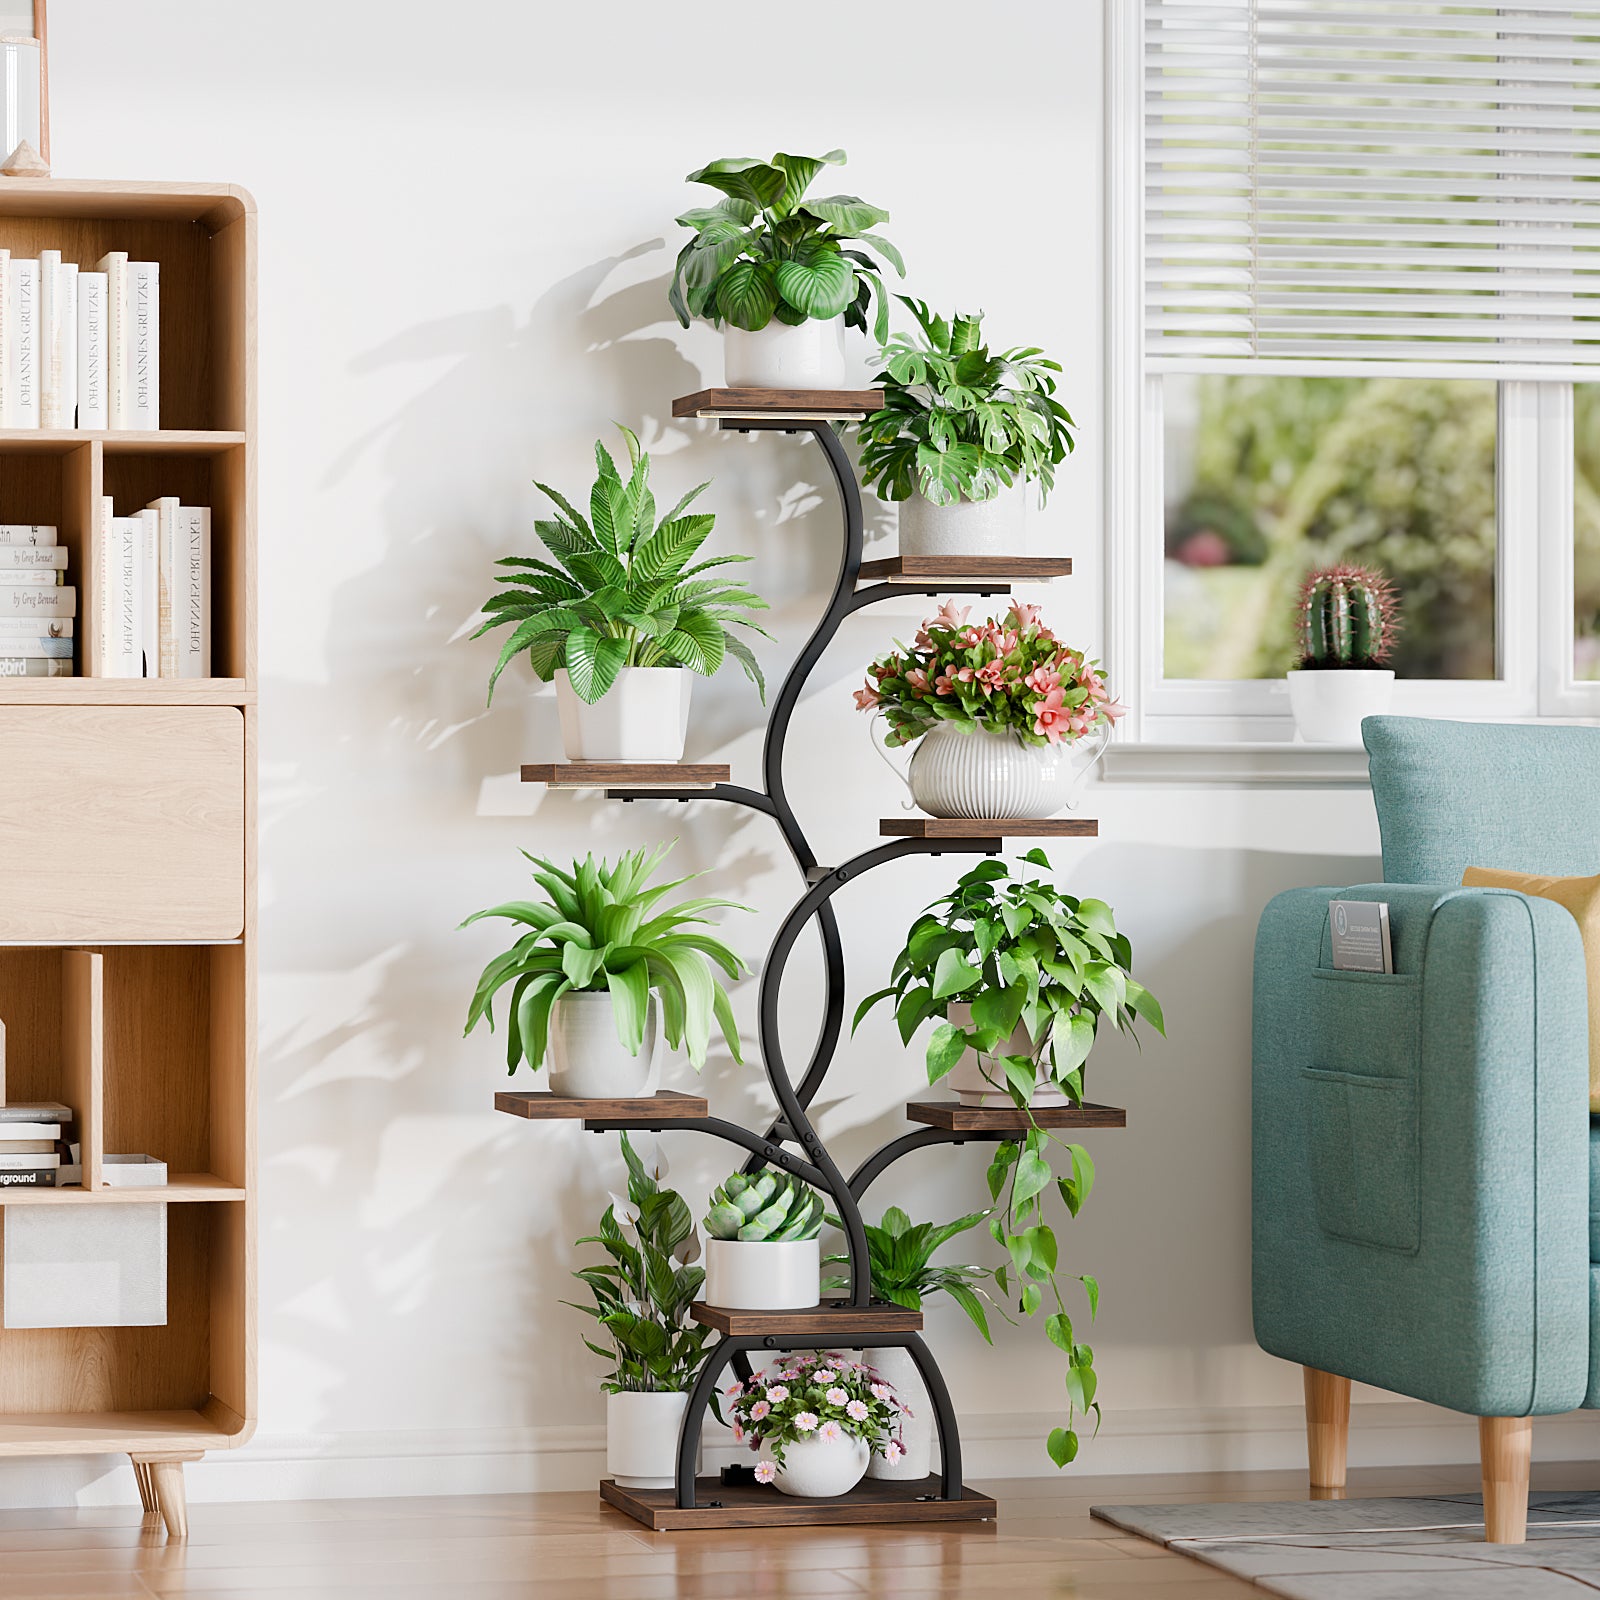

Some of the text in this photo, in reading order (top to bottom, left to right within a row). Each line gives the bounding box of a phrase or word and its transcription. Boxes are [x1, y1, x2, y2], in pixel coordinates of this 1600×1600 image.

[20, 336, 31, 408] JOHANNES
[89, 344, 98, 409] JOHANNES
[137, 338, 148, 409] JOHANNES
[21, 551, 34, 564] Greg
[35, 551, 53, 563] Bennet
[22, 592, 36, 608] Greg
[37, 592, 58, 605] Bennet
